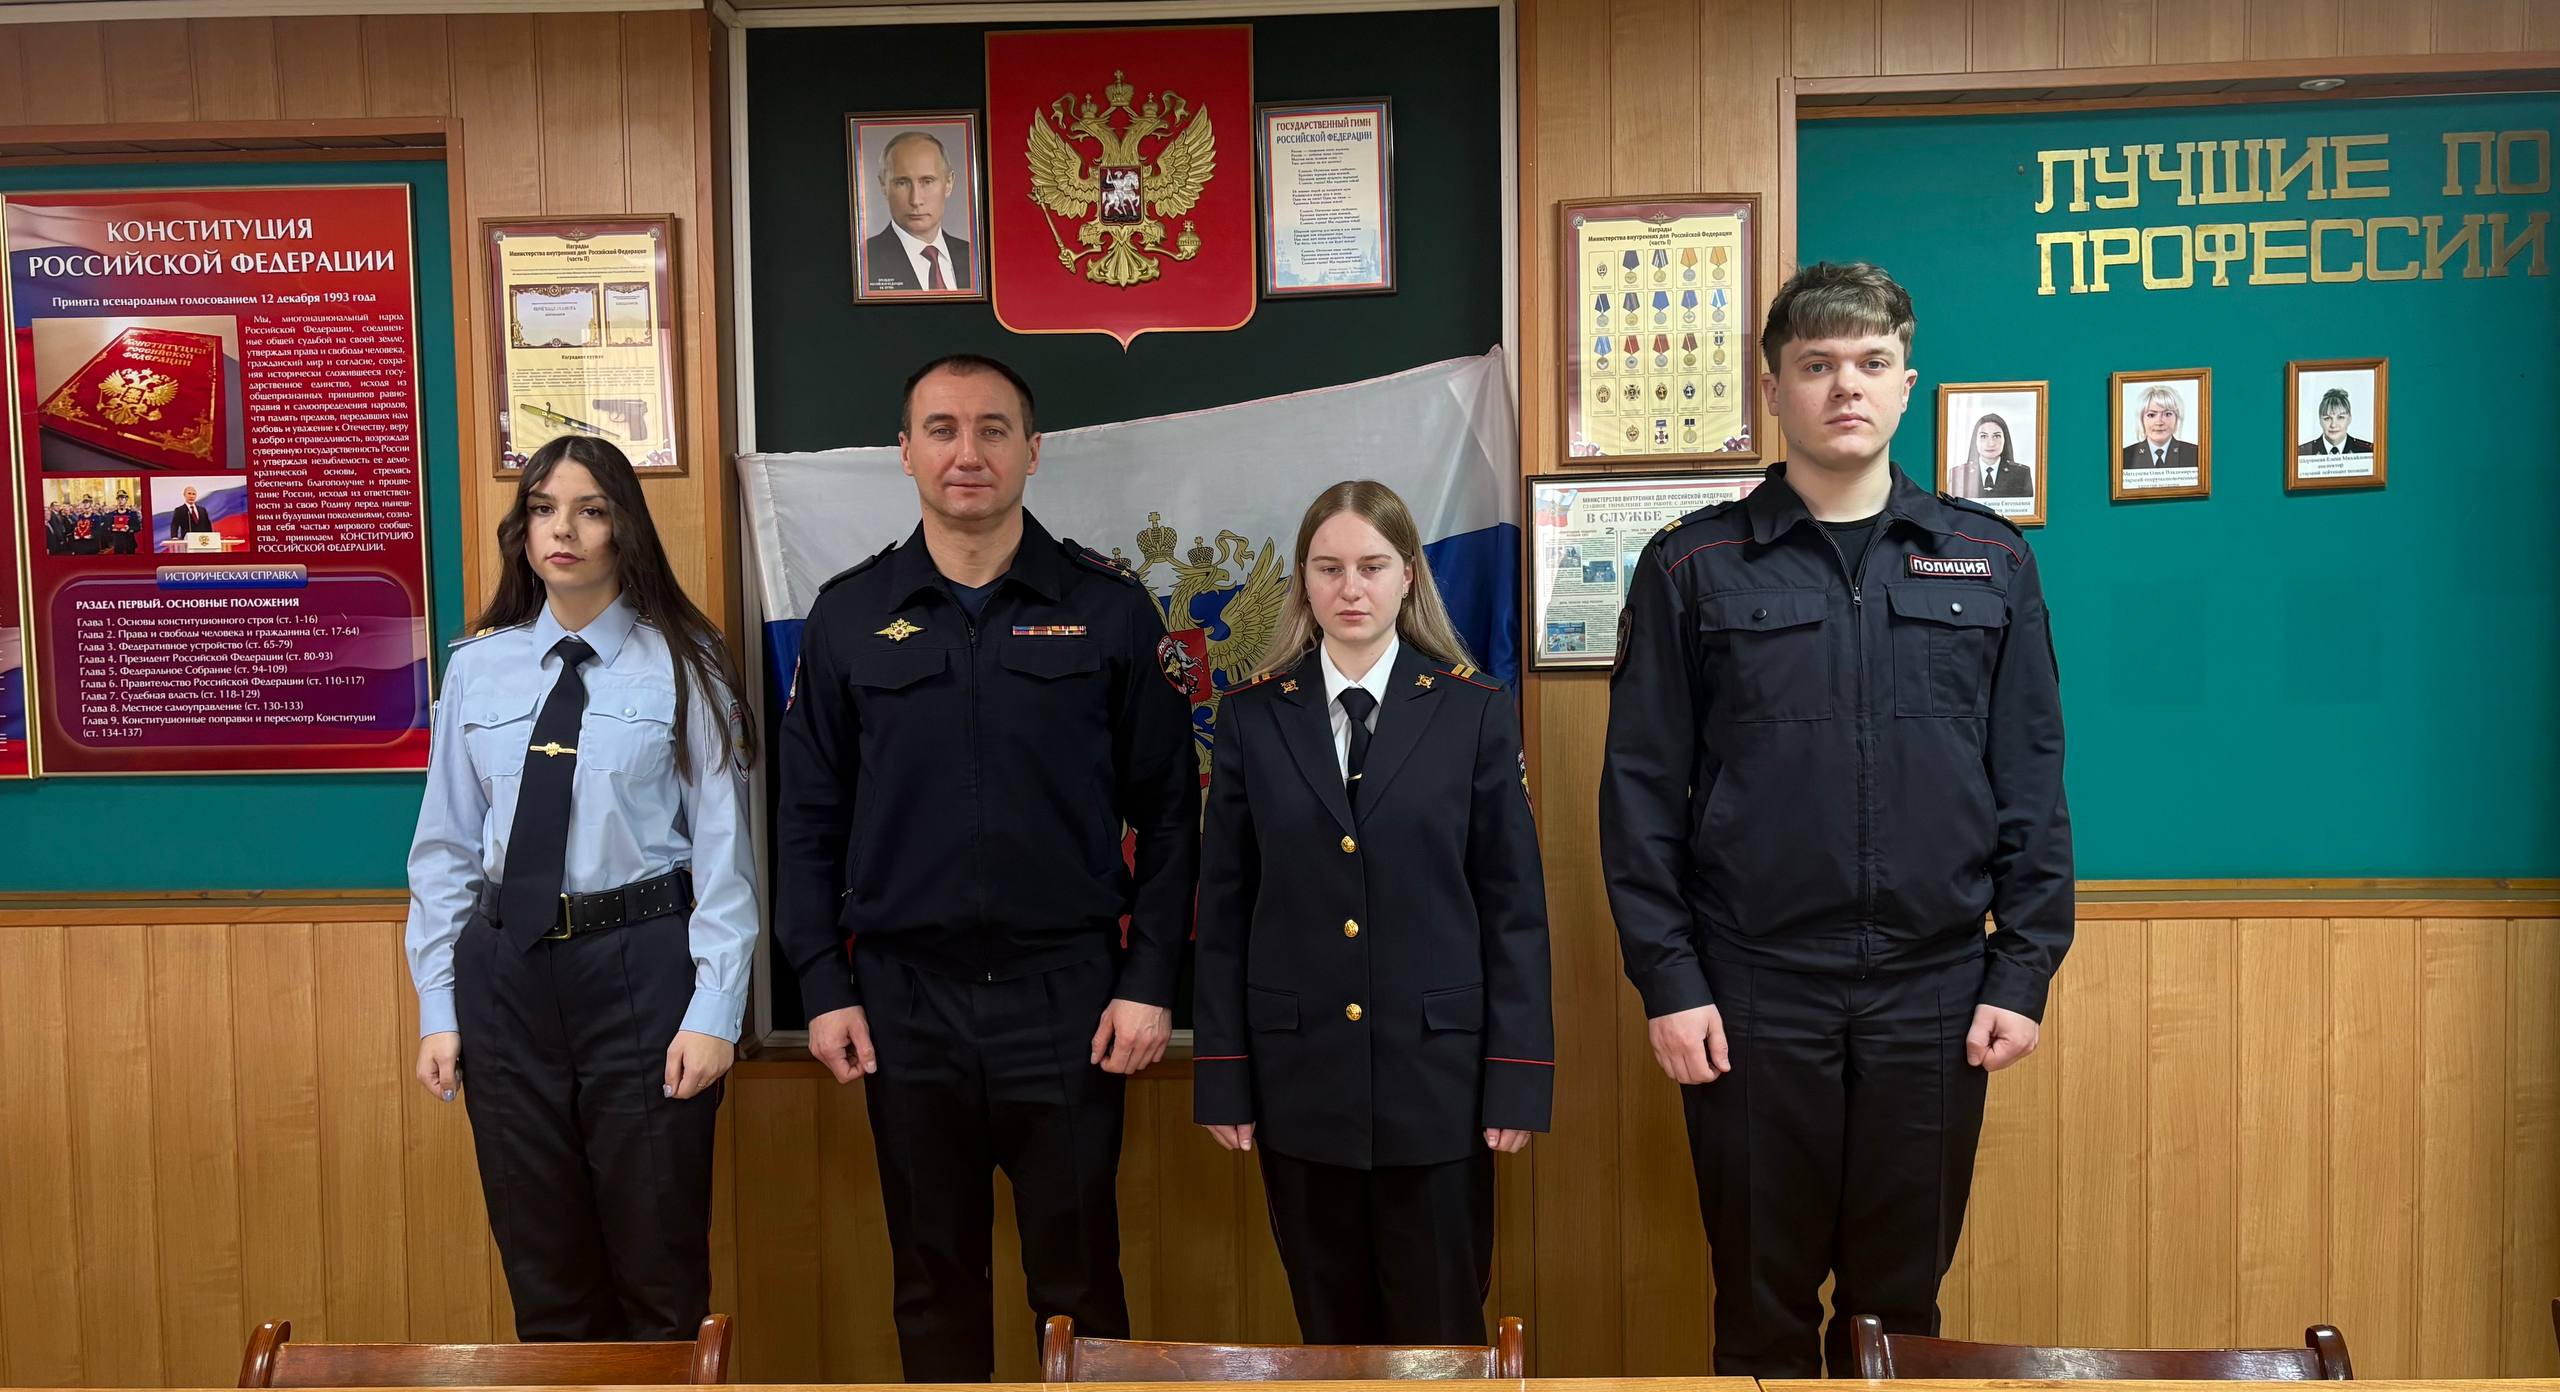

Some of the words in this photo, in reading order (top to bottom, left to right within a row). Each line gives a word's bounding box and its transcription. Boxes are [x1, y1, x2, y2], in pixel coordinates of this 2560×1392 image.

[1276, 117, 1349, 131] ГОСУДАРСТВЕННЫЙ
[1350, 118, 1371, 127] ГИМН
[1276, 131, 1326, 144] РОССИЙСКОЙ
[1327, 131, 1372, 142] ФЕДЕРАЦИИ
[2035, 134, 2390, 214] ЛУЧШИЕ
[2442, 130, 2550, 196] ПО
[106, 218, 313, 243] КОНСТИТУЦИЯ
[2036, 211, 2549, 295] ПРОФЕССИИ
[29, 250, 222, 277] РОССИЙСКОЙ
[230, 250, 394, 274] ФЕДЕРАЦИИ
[52, 296, 99, 309] Принята
[102, 297, 177, 308] всенародным
[179, 296, 257, 304] голосованием
[261, 293, 274, 303] 12
[276, 292, 320, 305] декабря
[323, 292, 349, 302] 1993
[352, 293, 376, 301] года
[281, 313, 368, 322] многонациональный
[378, 313, 404, 322] народ
[244, 325, 295, 334] Российской
[248, 381, 302, 391] дарственное
[252, 447, 303, 456] суверенную
[303, 446, 380, 455] государственность
[380, 443, 410, 452] России
[253, 468, 307, 478] кратической
[372, 467, 411, 476] стремясь
[253, 478, 303, 487] обеспечить
[306, 478, 365, 488] благополучие
[1586, 513, 1595, 523] В
[1600, 511, 1662, 523] СЛУЖБЕ
[285, 534, 333, 543] принимаем
[340, 531, 414, 540] КОНСТИТУЦИЮ
[257, 542, 325, 552] РОССИЙСКОЙ
[326, 542, 386, 551] ФЕДЕРАЦИИ.
[1913, 559, 1986, 574] ПОЛИЦИЯ
[164, 569, 248, 581] ИСТОРИЧЕСКАЯ
[250, 569, 298, 580] СПРАВКА
[75, 600, 115, 609] РАЗДЕЛ
[117, 598, 164, 609] ПЕРВЫЙ.
[165, 598, 228, 608] ОСНОВНЫЕ
[230, 597, 299, 607] ПОЛОЖЕНИЯ
[76, 617, 103, 626] Глава
[106, 617, 115, 626] 1.
[116, 617, 155, 626] Основы
[157, 617, 245, 627] конституционного
[246, 617, 273, 626] строя
[275, 614, 291, 624] (ст.
[294, 614, 318, 624] 1-16)
[77, 629, 104, 639] Глава
[106, 629, 116, 638] 2.
[117, 629, 148, 640] Права
[158, 628, 199, 637] свободы
[200, 629, 244, 637] человека
[254, 629, 310, 639] гражданина
[312, 626, 328, 636] (ст.
[331, 626, 359, 635] 17-64)
[78, 642, 104, 651] Глава
[107, 642, 116, 651] 3.
[118, 641, 188, 652] Федеративное
[189, 641, 243, 652] устройство
[244, 639, 261, 649] (ст.
[263, 639, 293, 649] 65-79)
[78, 654, 105, 663] Глава
[107, 654, 117, 663] 4.
[118, 653, 170, 665] Президент
[172, 653, 228, 662] Российской
[229, 652, 283, 663] Федерации
[285, 651, 301, 661] (ст.
[303, 651, 333, 660] 80-93)
[79, 666, 106, 676] Глава
[108, 666, 118, 675] 5.
[119, 666, 183, 677] Федеральное
[184, 665, 232, 676] Собрание
[233, 664, 249, 674] (ст.
[251, 664, 287, 673] 94-109)
[80, 679, 106, 688] Глава
[108, 679, 118, 688] 6.
[120, 678, 191, 690] Правительство
[193, 677, 248, 686] Российской
[250, 676, 304, 688] Федерации
[305, 676, 322, 685] (ст.
[325, 675, 365, 685] 110-117)
[80, 691, 107, 700] Глава
[109, 691, 119, 700] 7.
[120, 690, 165, 702] Судебная
[167, 691, 199, 699] власть
[200, 689, 216, 699] (ст.
[219, 688, 260, 698] 118-129)
[81, 703, 108, 712] Глава
[109, 703, 120, 712] 8.
[121, 703, 163, 712] Местное
[164, 703, 242, 713] самоуправление
[244, 701, 260, 710] (ст.
[263, 700, 303, 710] 130-133)
[82, 715, 108, 725] Глава
[110, 715, 120, 724] 9.
[121, 715, 206, 726] Конституционные
[208, 715, 253, 725] поправки
[263, 715, 314, 725] пересмотр
[316, 712, 375, 724] Конституции
[82, 728, 98, 737] (ст.
[101, 727, 142, 737] 134-137)
